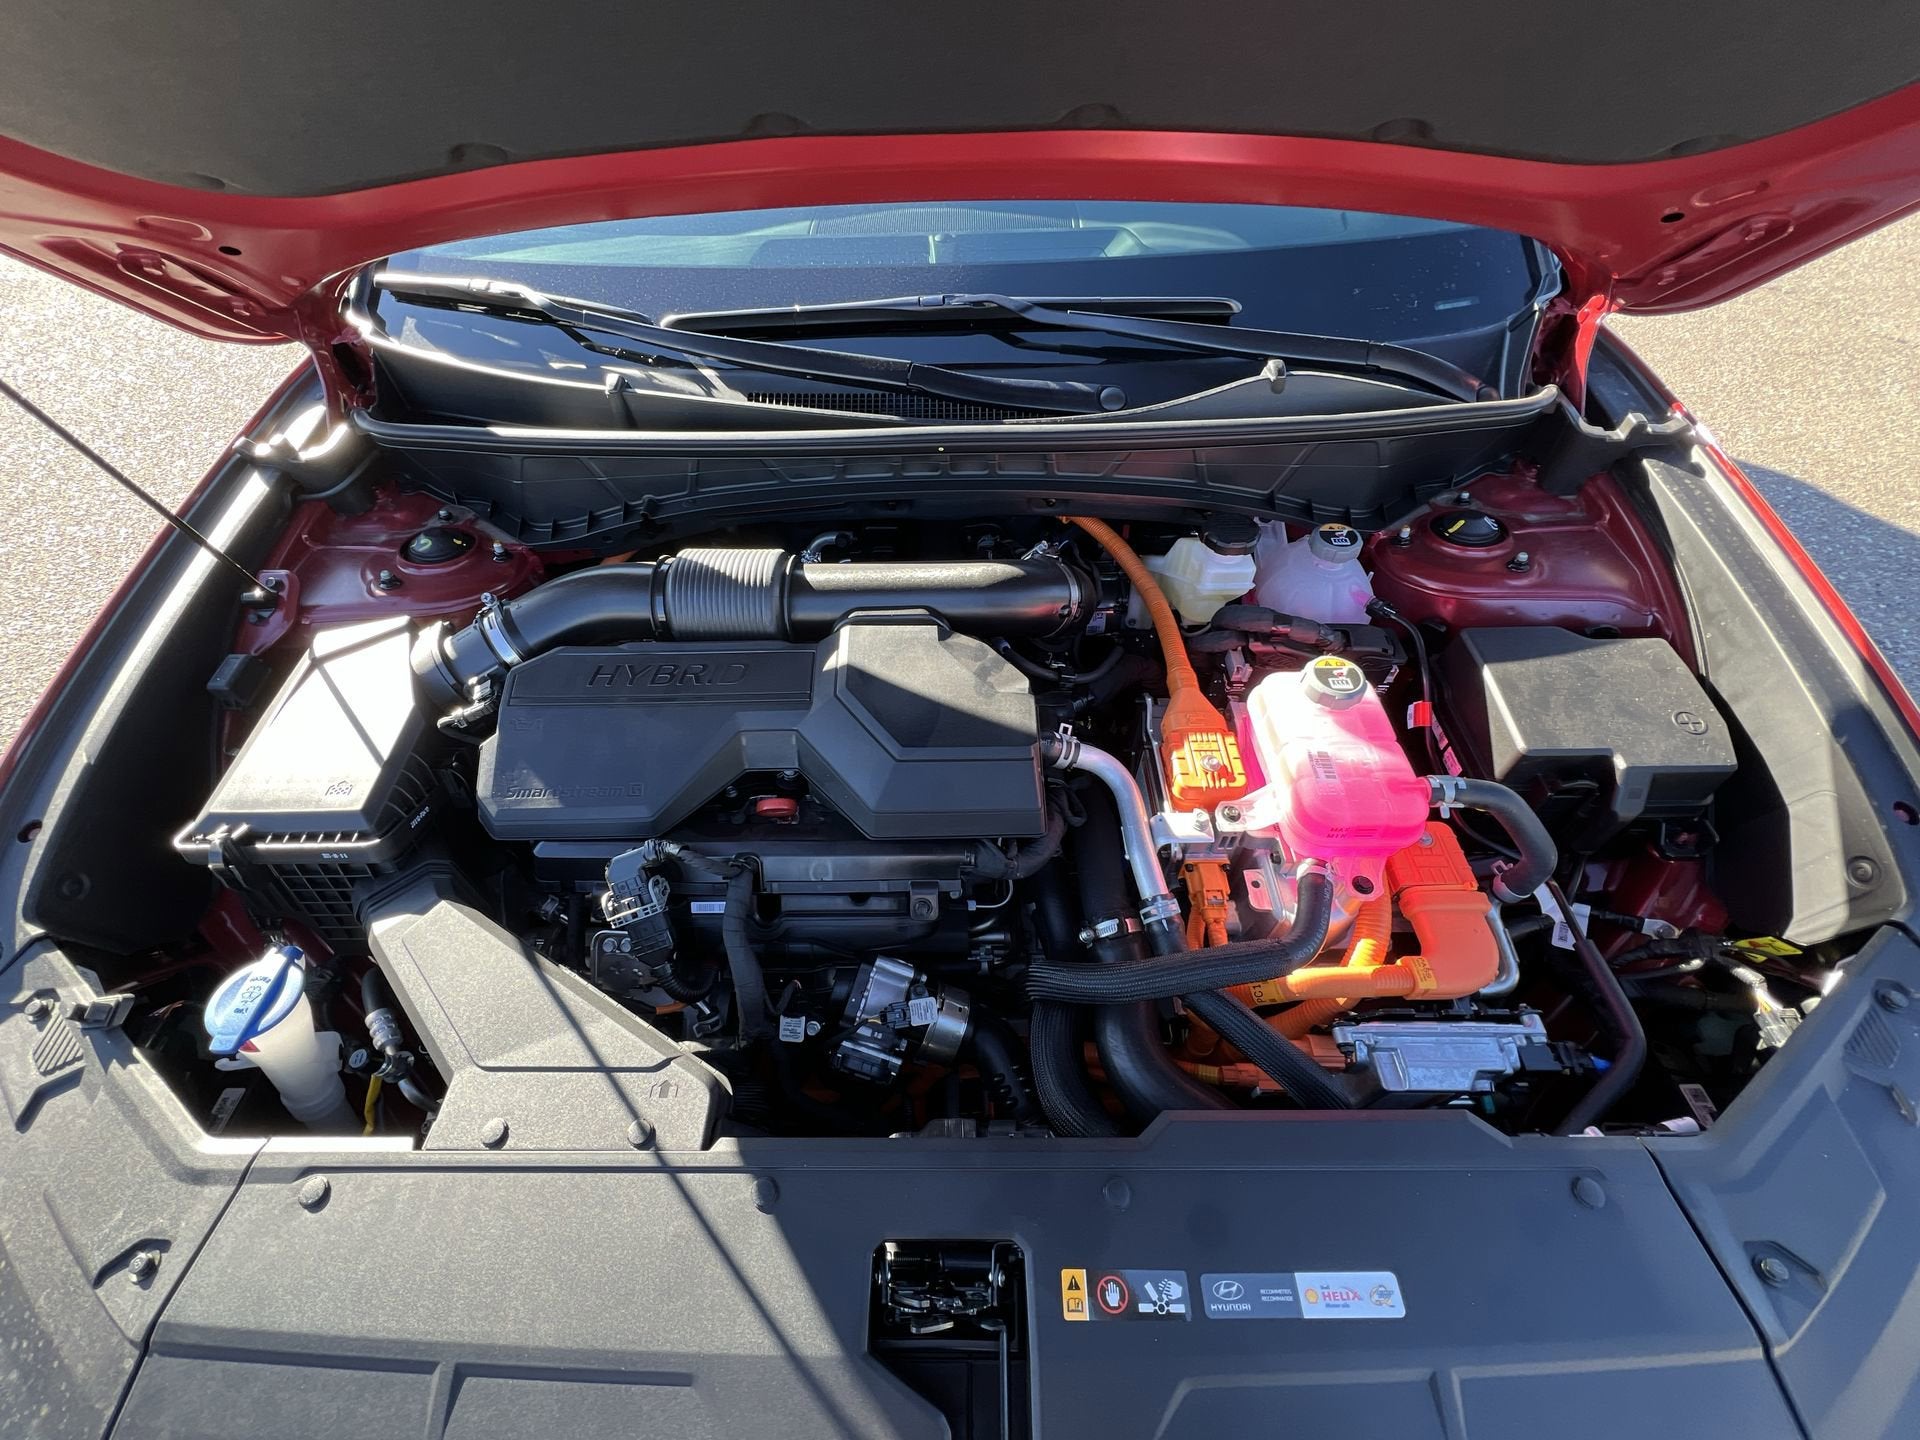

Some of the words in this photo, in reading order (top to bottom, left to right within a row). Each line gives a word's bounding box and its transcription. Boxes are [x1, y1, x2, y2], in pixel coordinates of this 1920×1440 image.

[586, 663, 746, 687] HYBRID
[503, 784, 624, 799] Smartstream
[1322, 1291, 1361, 1301] HELIX
[1210, 1303, 1251, 1311] HYUNDAI
